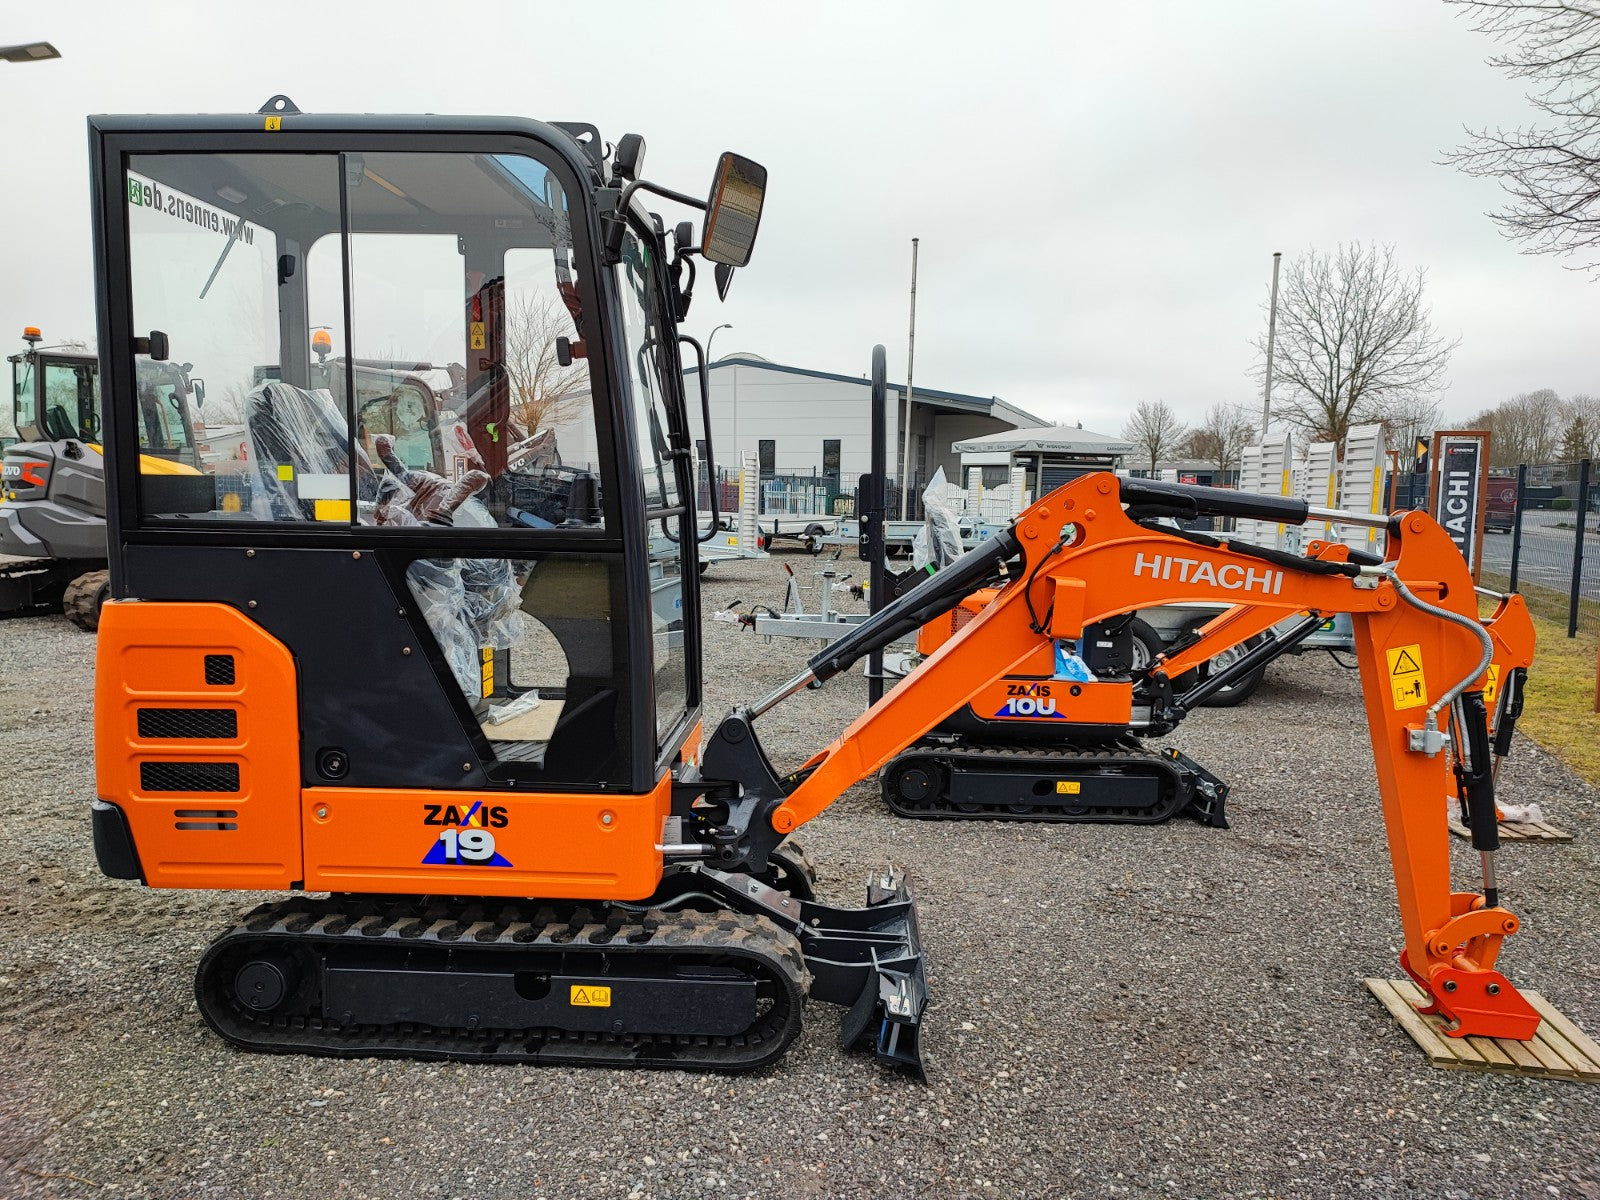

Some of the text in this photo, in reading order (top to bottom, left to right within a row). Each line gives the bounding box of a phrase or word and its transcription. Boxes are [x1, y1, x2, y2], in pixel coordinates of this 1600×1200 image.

[1133, 552, 1284, 595] HITACHI
[1007, 683, 1051, 697] ZAXIS
[1006, 697, 1056, 716] 10U
[423, 800, 509, 828] ZAXIS
[439, 828, 496, 863] 19
